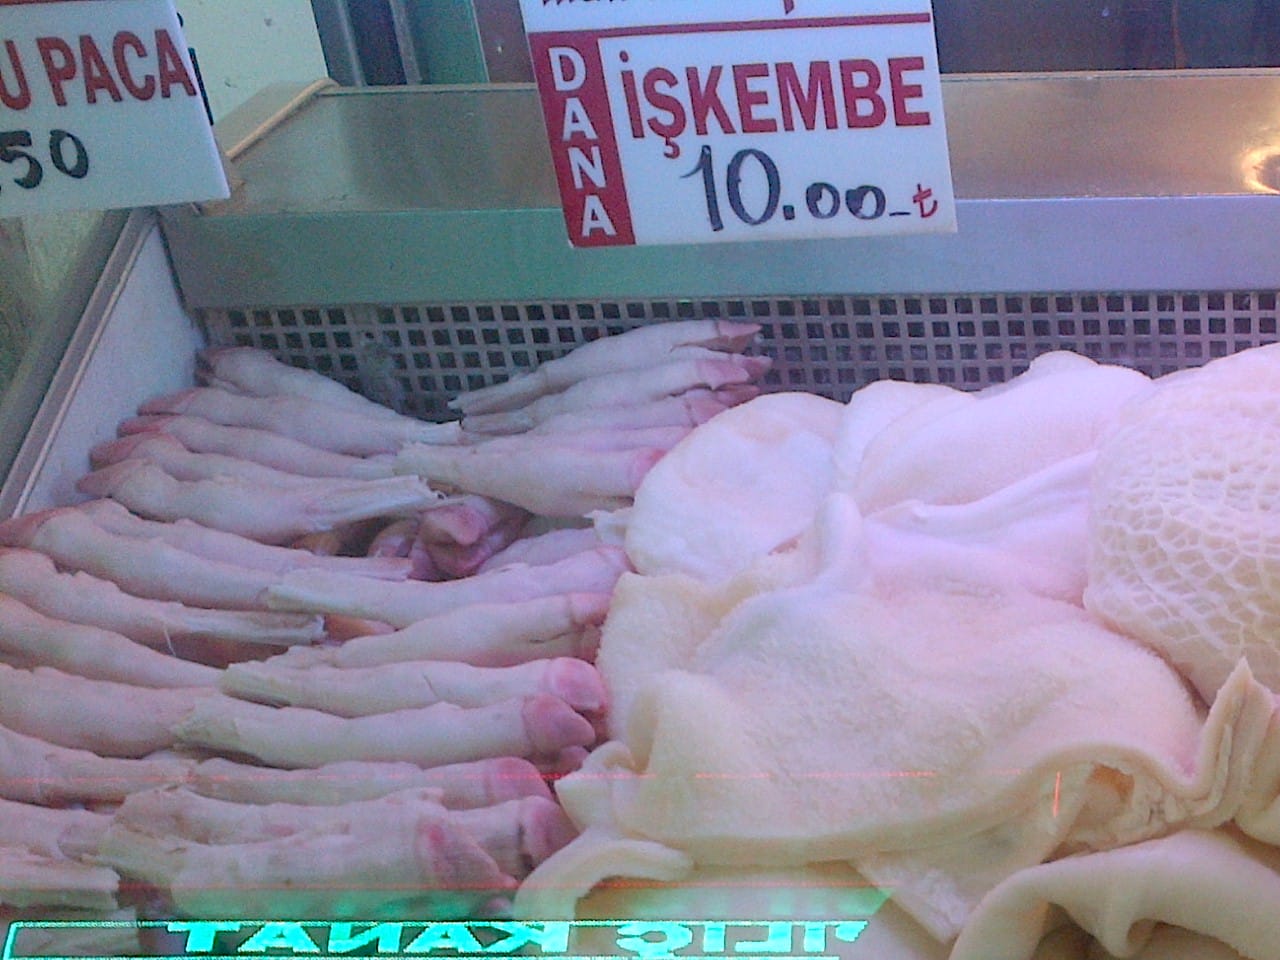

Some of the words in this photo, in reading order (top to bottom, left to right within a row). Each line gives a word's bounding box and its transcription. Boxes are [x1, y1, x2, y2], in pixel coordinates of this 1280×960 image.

[36, 28, 198, 107] PACA
[619, 50, 932, 159] İŞKEMBE
[547, 46, 617, 238] DANA
